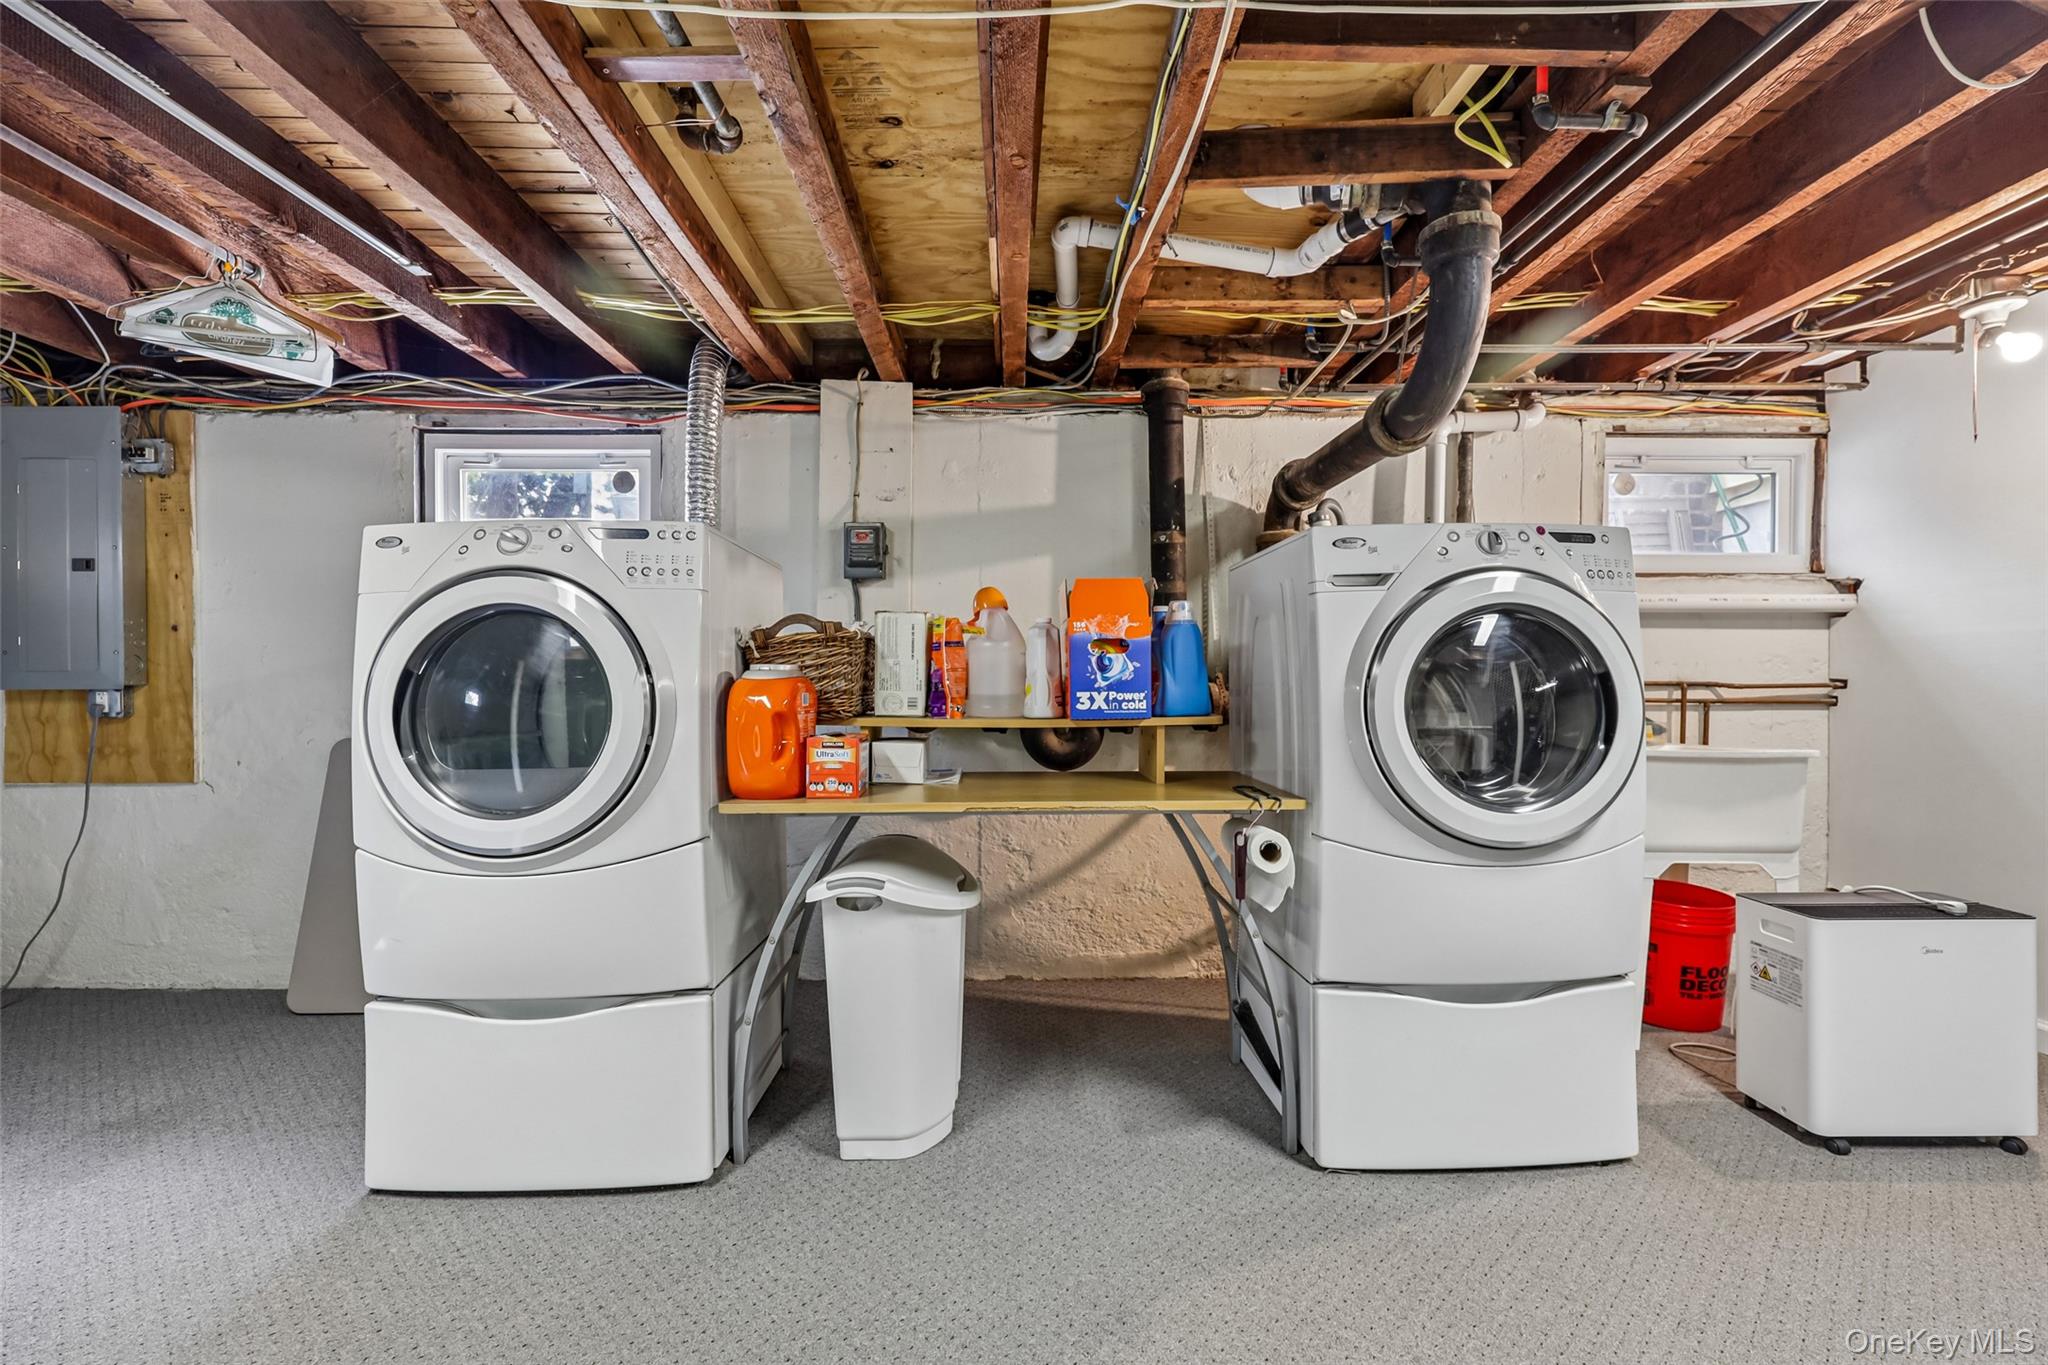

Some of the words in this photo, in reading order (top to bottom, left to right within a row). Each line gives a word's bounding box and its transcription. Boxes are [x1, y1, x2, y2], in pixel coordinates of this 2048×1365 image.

[1075, 691, 1109, 711] 3X
[1109, 700, 1119, 710] in
[1121, 700, 1147, 710] cold
